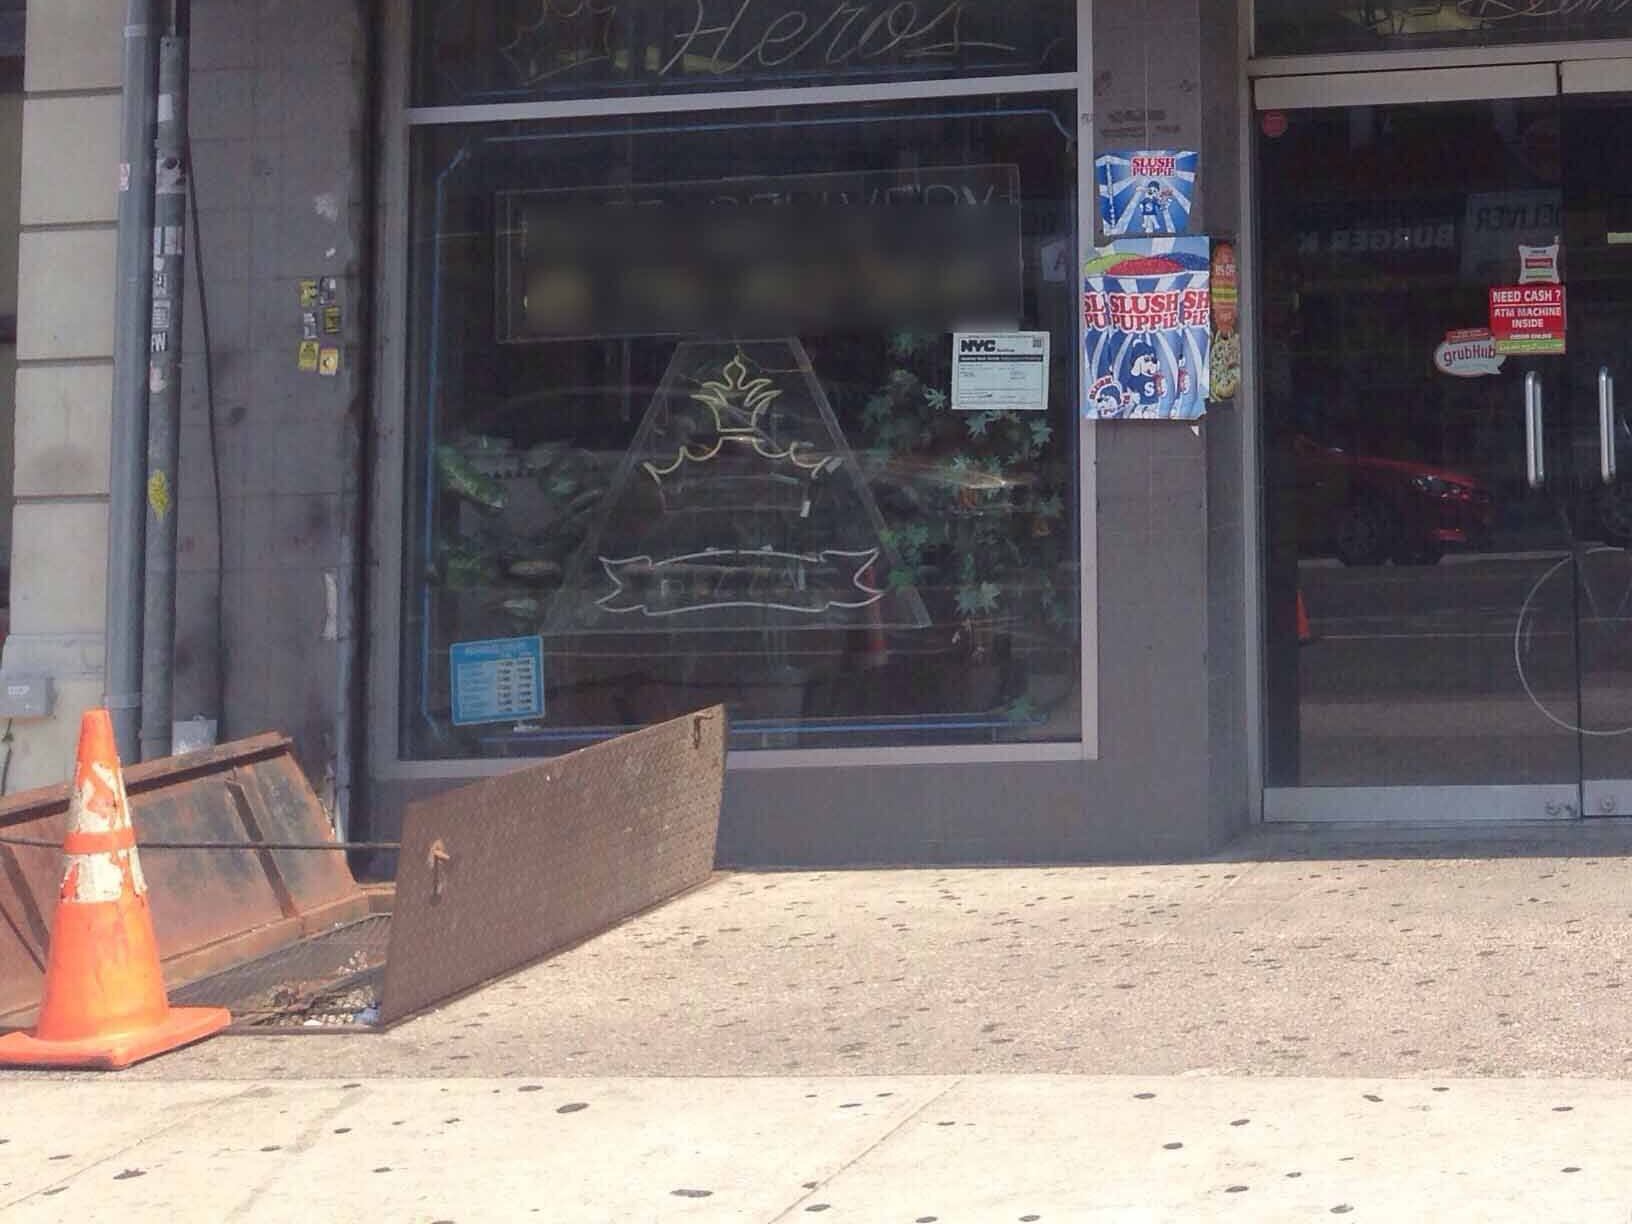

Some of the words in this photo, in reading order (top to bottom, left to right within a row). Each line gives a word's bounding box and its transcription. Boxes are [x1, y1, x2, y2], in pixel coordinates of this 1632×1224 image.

[1133, 158, 1175, 168] SLUSH
[1110, 291, 1179, 314] SLUSH
[1493, 290, 1521, 303] NEED
[1523, 290, 1553, 302] CASH
[1494, 308, 1515, 317] ATM
[1517, 306, 1561, 317] MACHINE
[1511, 318, 1544, 329] INSIDE
[960, 339, 996, 353] NYC
